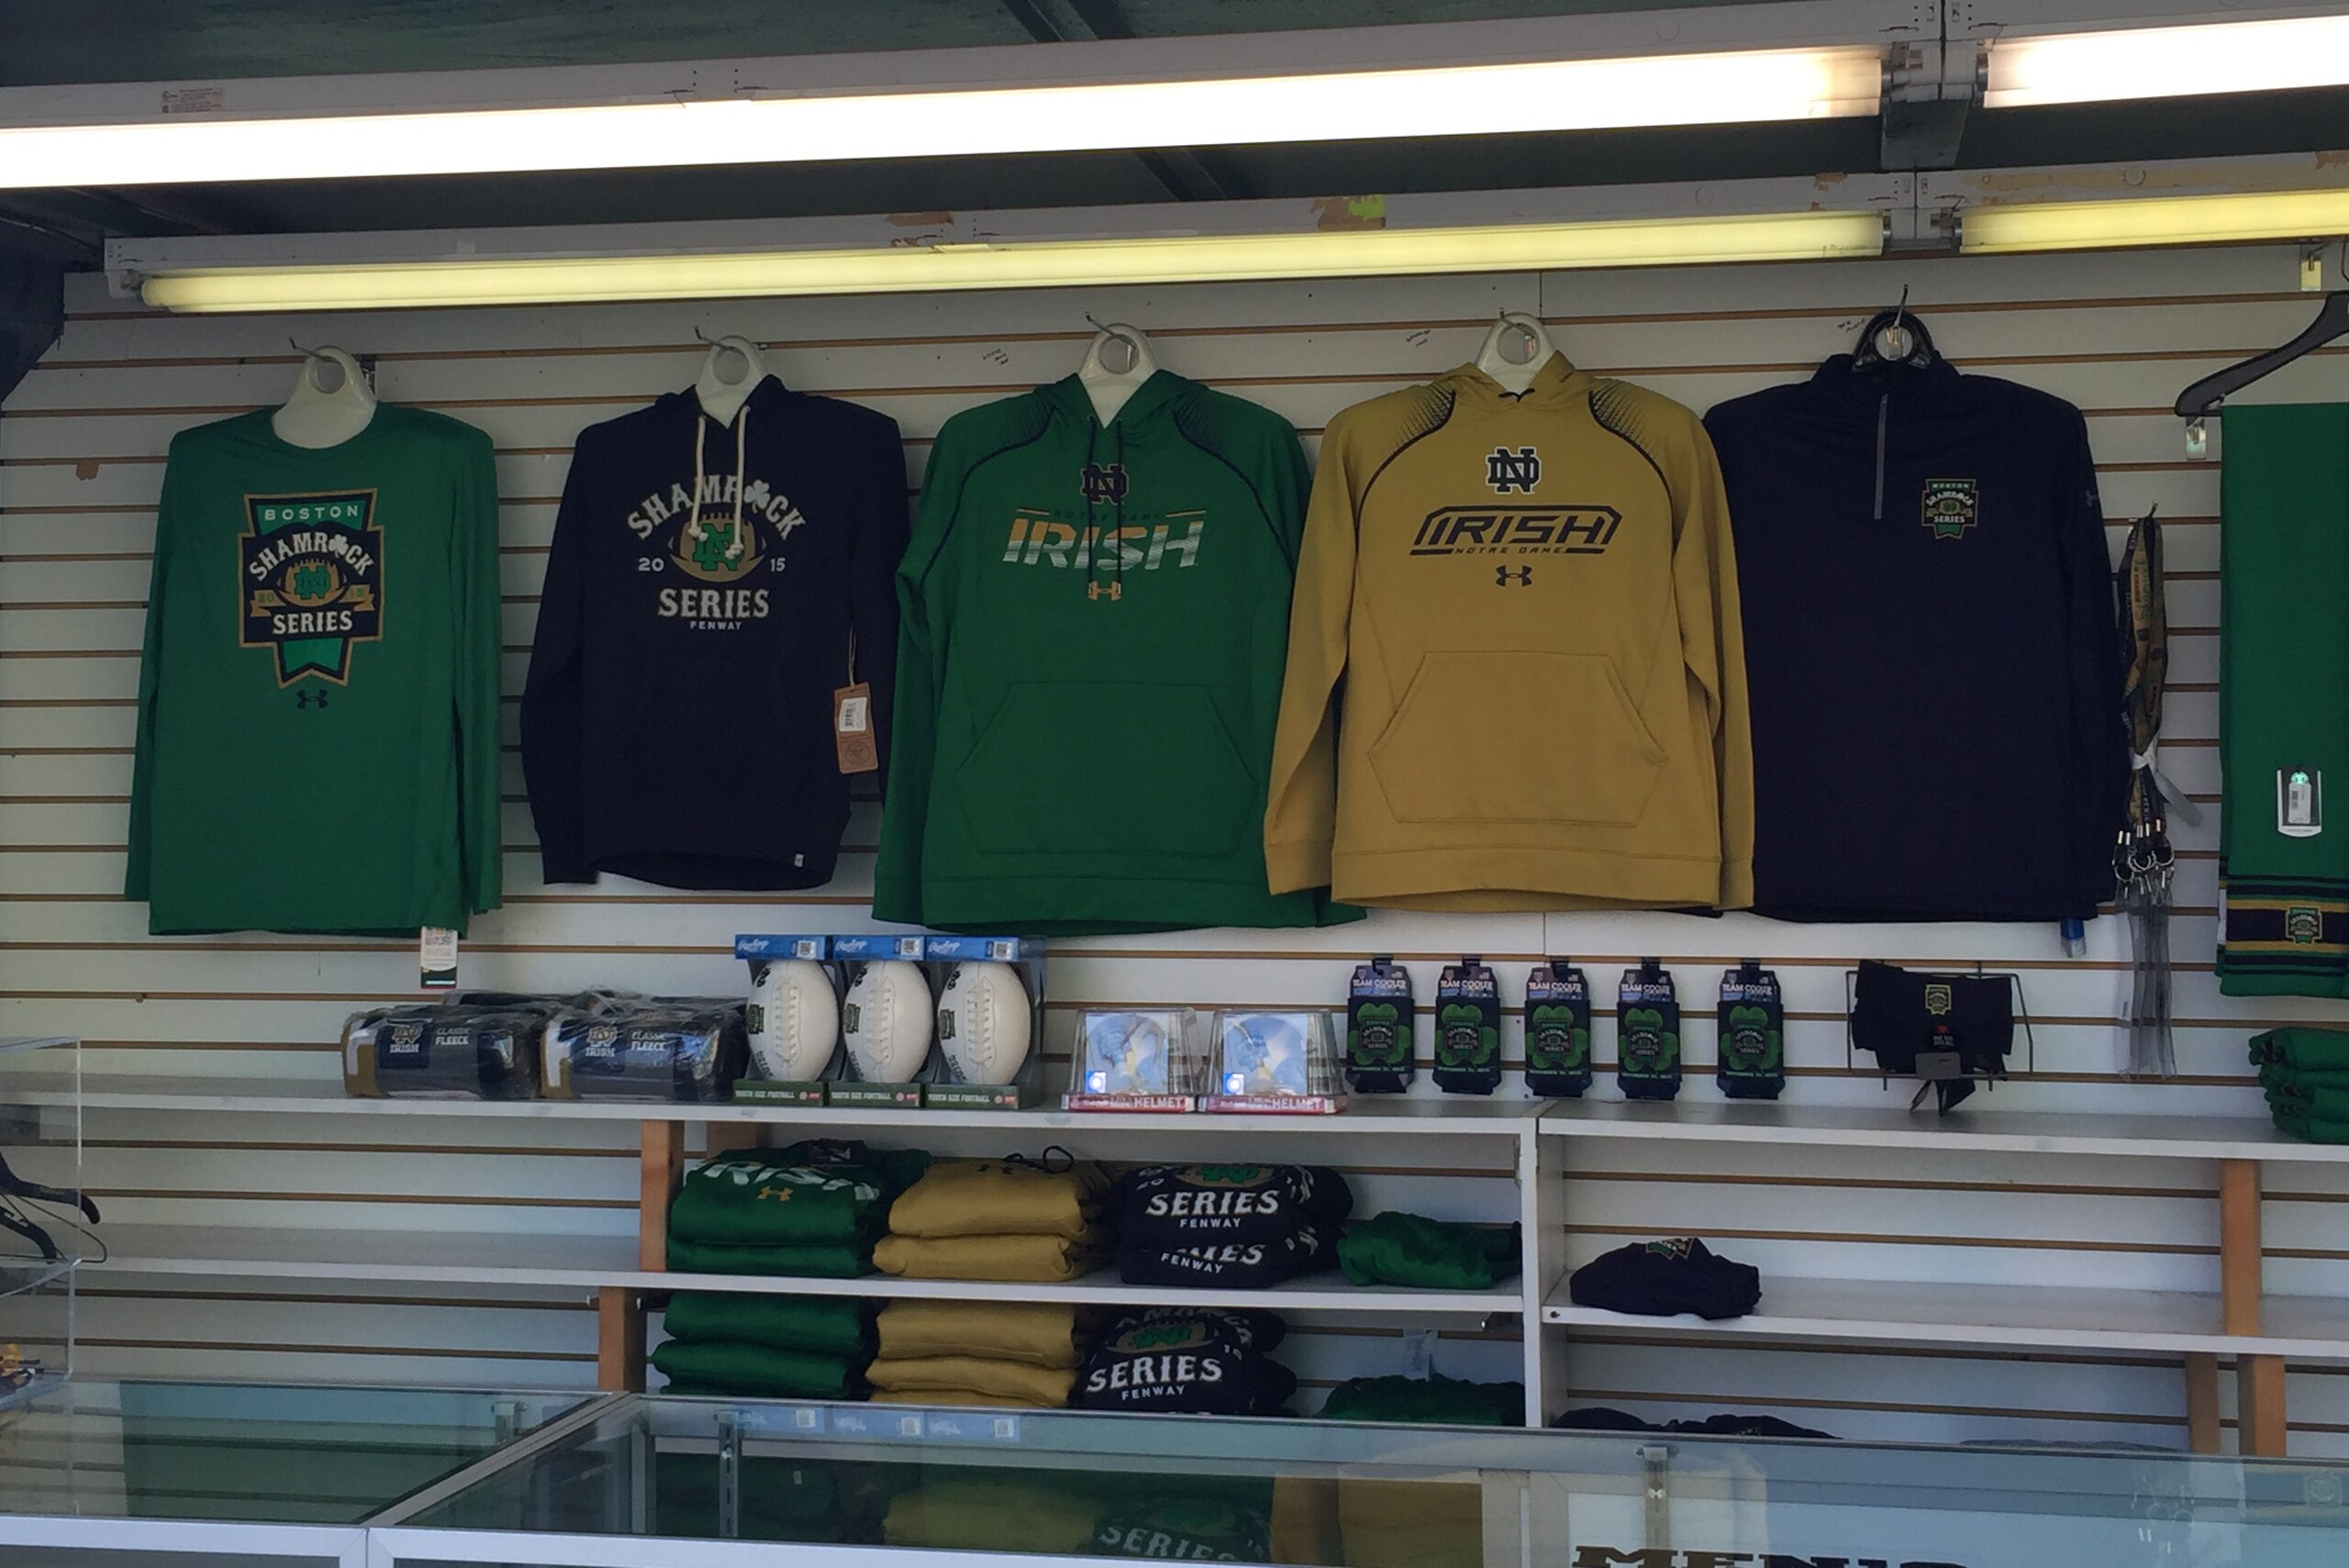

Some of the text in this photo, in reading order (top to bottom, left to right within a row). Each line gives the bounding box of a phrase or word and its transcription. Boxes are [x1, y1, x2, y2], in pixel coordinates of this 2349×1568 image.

[264, 505, 359, 521] BOSTON
[1933, 515, 1965, 523] SERIES
[1427, 516, 1606, 546] IRISH
[1003, 517, 1206, 571] IRISH
[639, 557, 786, 572] 20 15
[658, 588, 769, 618] SERIES
[273, 610, 353, 634] SERIES
[690, 621, 742, 630] FENWAY
[1353, 979, 1373, 987] TEAM
[1440, 980, 1461, 988] TEAM
[1529, 982, 1550, 990] TEAM
[1621, 984, 1642, 992] TEAM
[1722, 984, 1743, 992] TEAM
[435, 1036, 469, 1045] FLEECE
[630, 1040, 666, 1051] FLEECE
[390, 1043, 420, 1053] IRISH
[585, 1047, 616, 1057] IRISH
[1134, 1095, 1184, 1108] HELMET
[1272, 1097, 1321, 1109] HELMET
[1145, 1190, 1281, 1217] SERIES
[1180, 1218, 1241, 1229] FENWAY
[1161, 1252, 1224, 1274] FENWAY
[1086, 1355, 1223, 1393] SERIES
[1121, 1385, 1186, 1401] FENWAY
